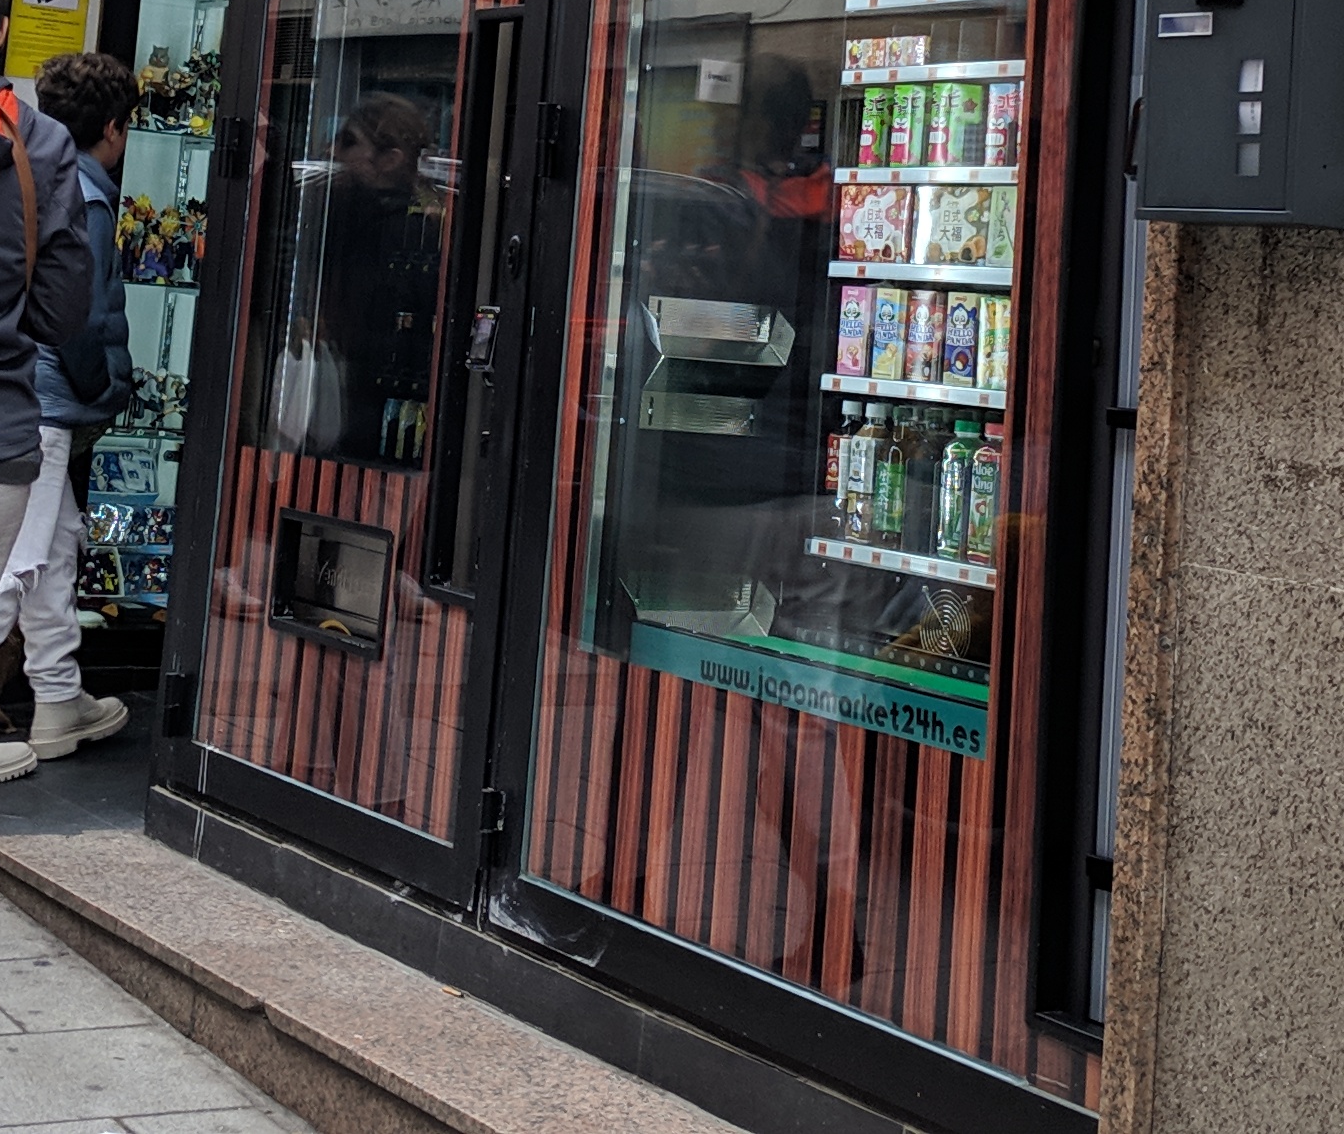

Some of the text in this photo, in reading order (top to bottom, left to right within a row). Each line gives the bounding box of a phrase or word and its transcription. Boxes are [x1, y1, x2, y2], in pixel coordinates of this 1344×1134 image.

[972, 463, 994, 477] Aloe
[972, 475, 994, 493] King
[699, 658, 981, 754] www.japonmarket24h.es
